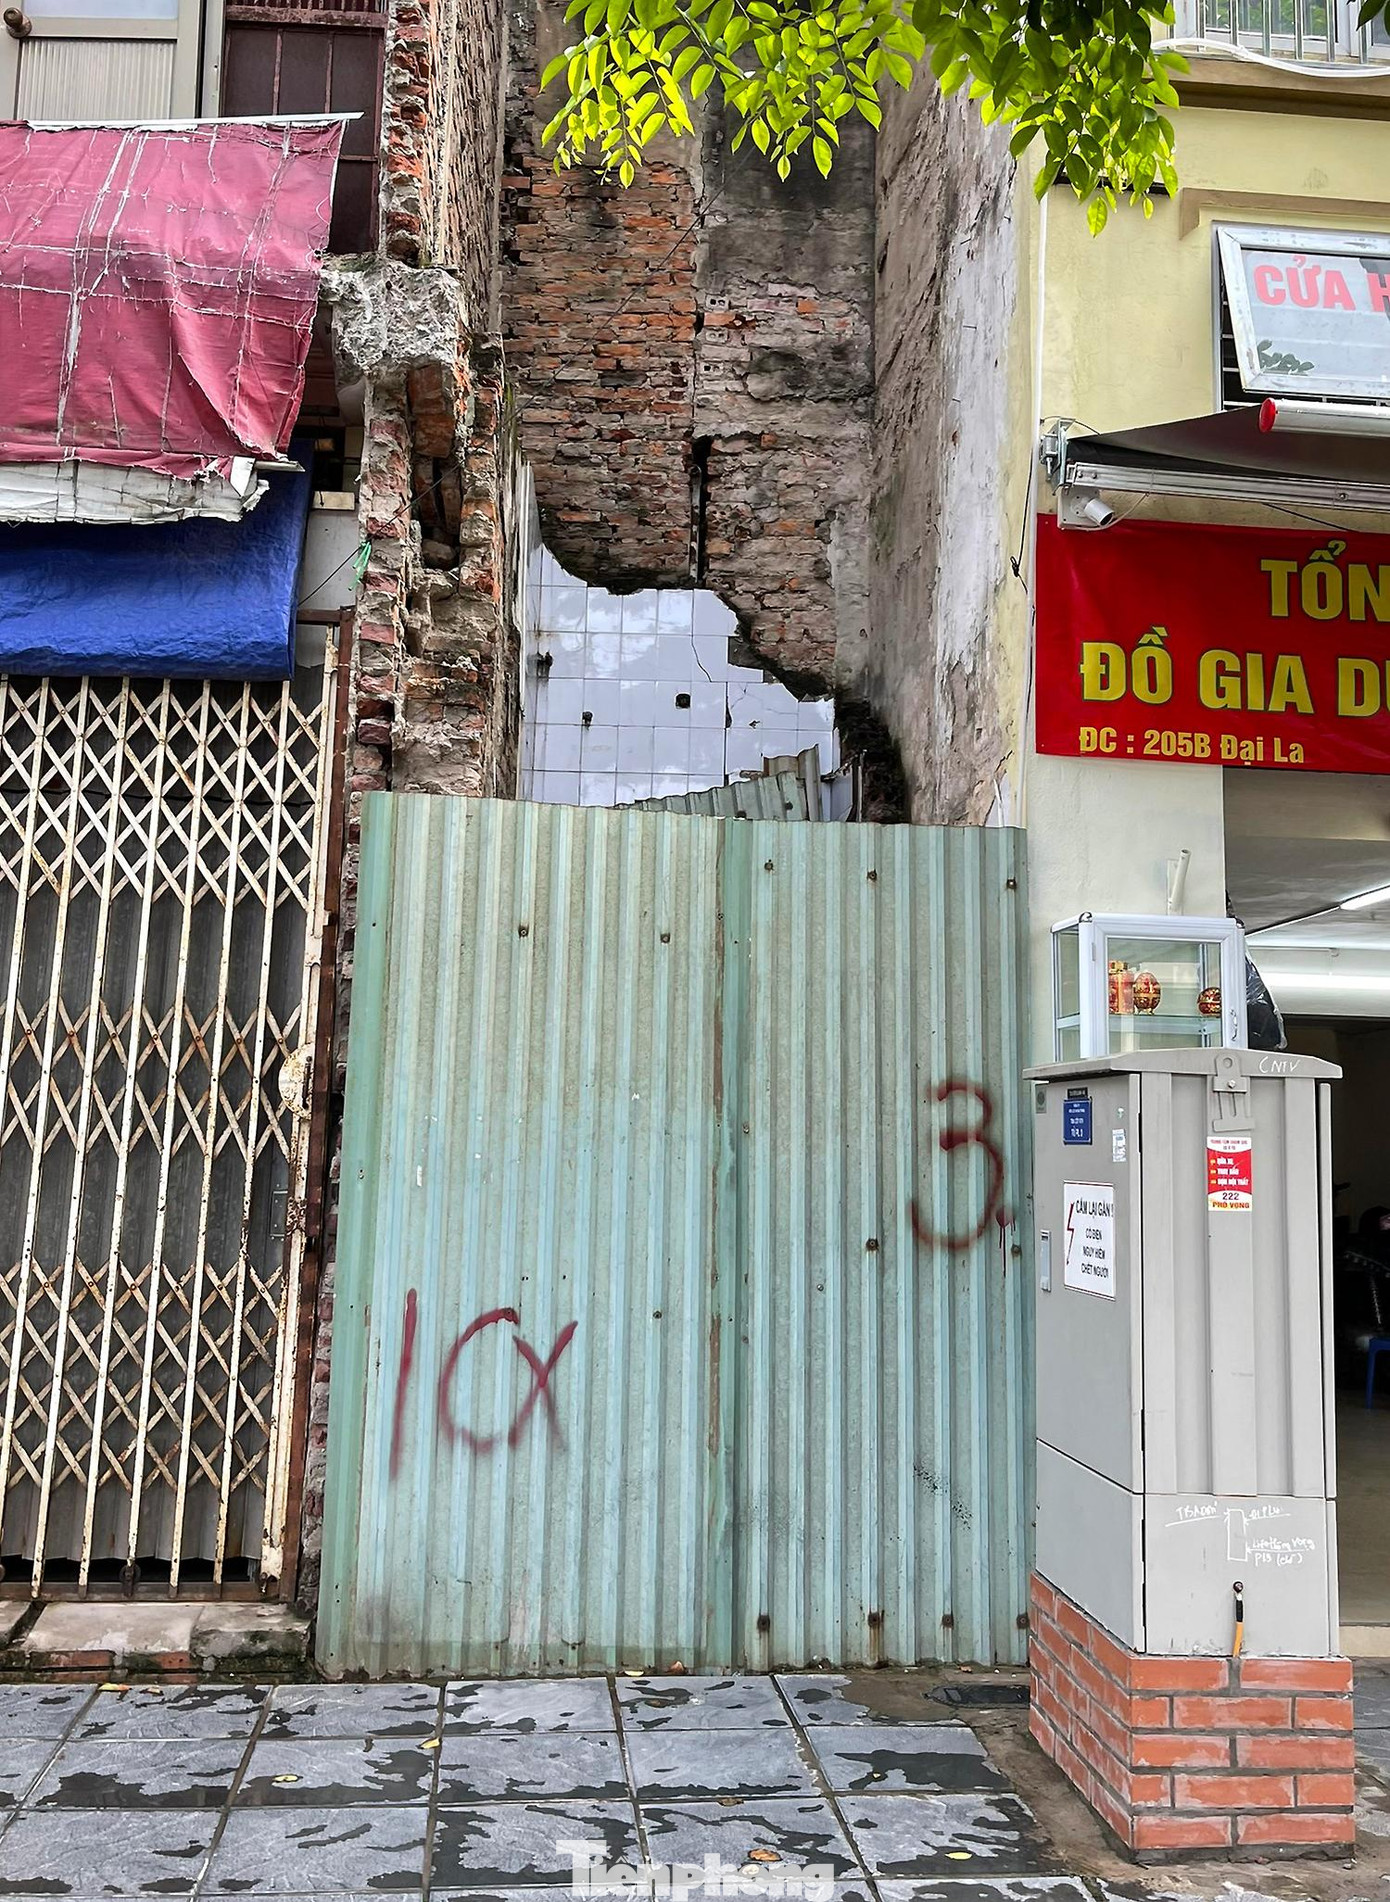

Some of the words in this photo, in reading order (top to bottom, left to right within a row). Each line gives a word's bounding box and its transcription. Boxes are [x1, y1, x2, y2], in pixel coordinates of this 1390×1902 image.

[1254, 255, 1356, 311] CỬA
[1261, 539, 1390, 622] TỔN
[1079, 625, 1173, 705] ĐỒ
[1199, 649, 1315, 714] GIA
[1337, 657, 1390, 718] D
[1079, 726, 1117, 753] ĐC
[1143, 729, 1211, 759] 205B
[1219, 734, 1264, 766] Đại
[1273, 737, 1304, 763] La
[1222, 1192, 1240, 1201] 222
